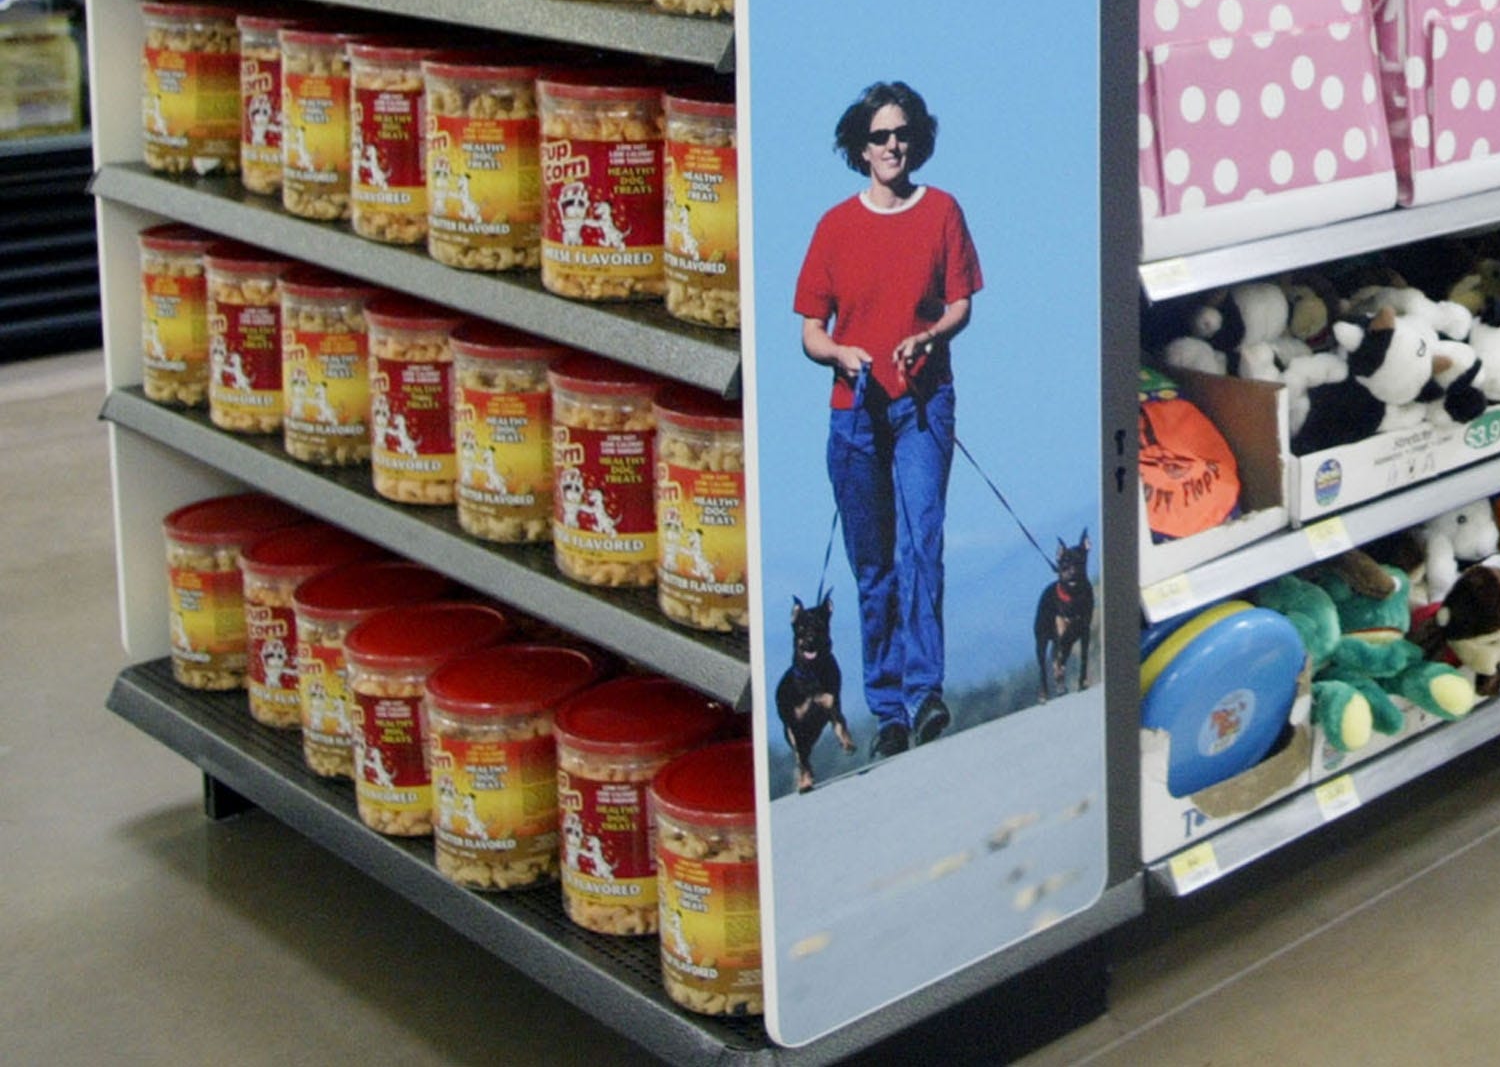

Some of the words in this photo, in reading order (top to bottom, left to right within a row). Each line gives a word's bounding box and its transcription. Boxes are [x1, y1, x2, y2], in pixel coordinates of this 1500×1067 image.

[607, 165, 655, 178] HEALTHY
[620, 176, 644, 187] DOG
[613, 184, 653, 195] TREATS
[575, 248, 654, 266] FLAVORED
[599, 456, 646, 467] HEALTHY
[610, 466, 633, 476] DOG
[605, 473, 643, 484] TREATS
[694, 495, 740, 508] HEALTHY
[700, 512, 736, 526] TREATS
[574, 535, 645, 553] FLAVORED
[690, 578, 745, 596] FLAVORED
